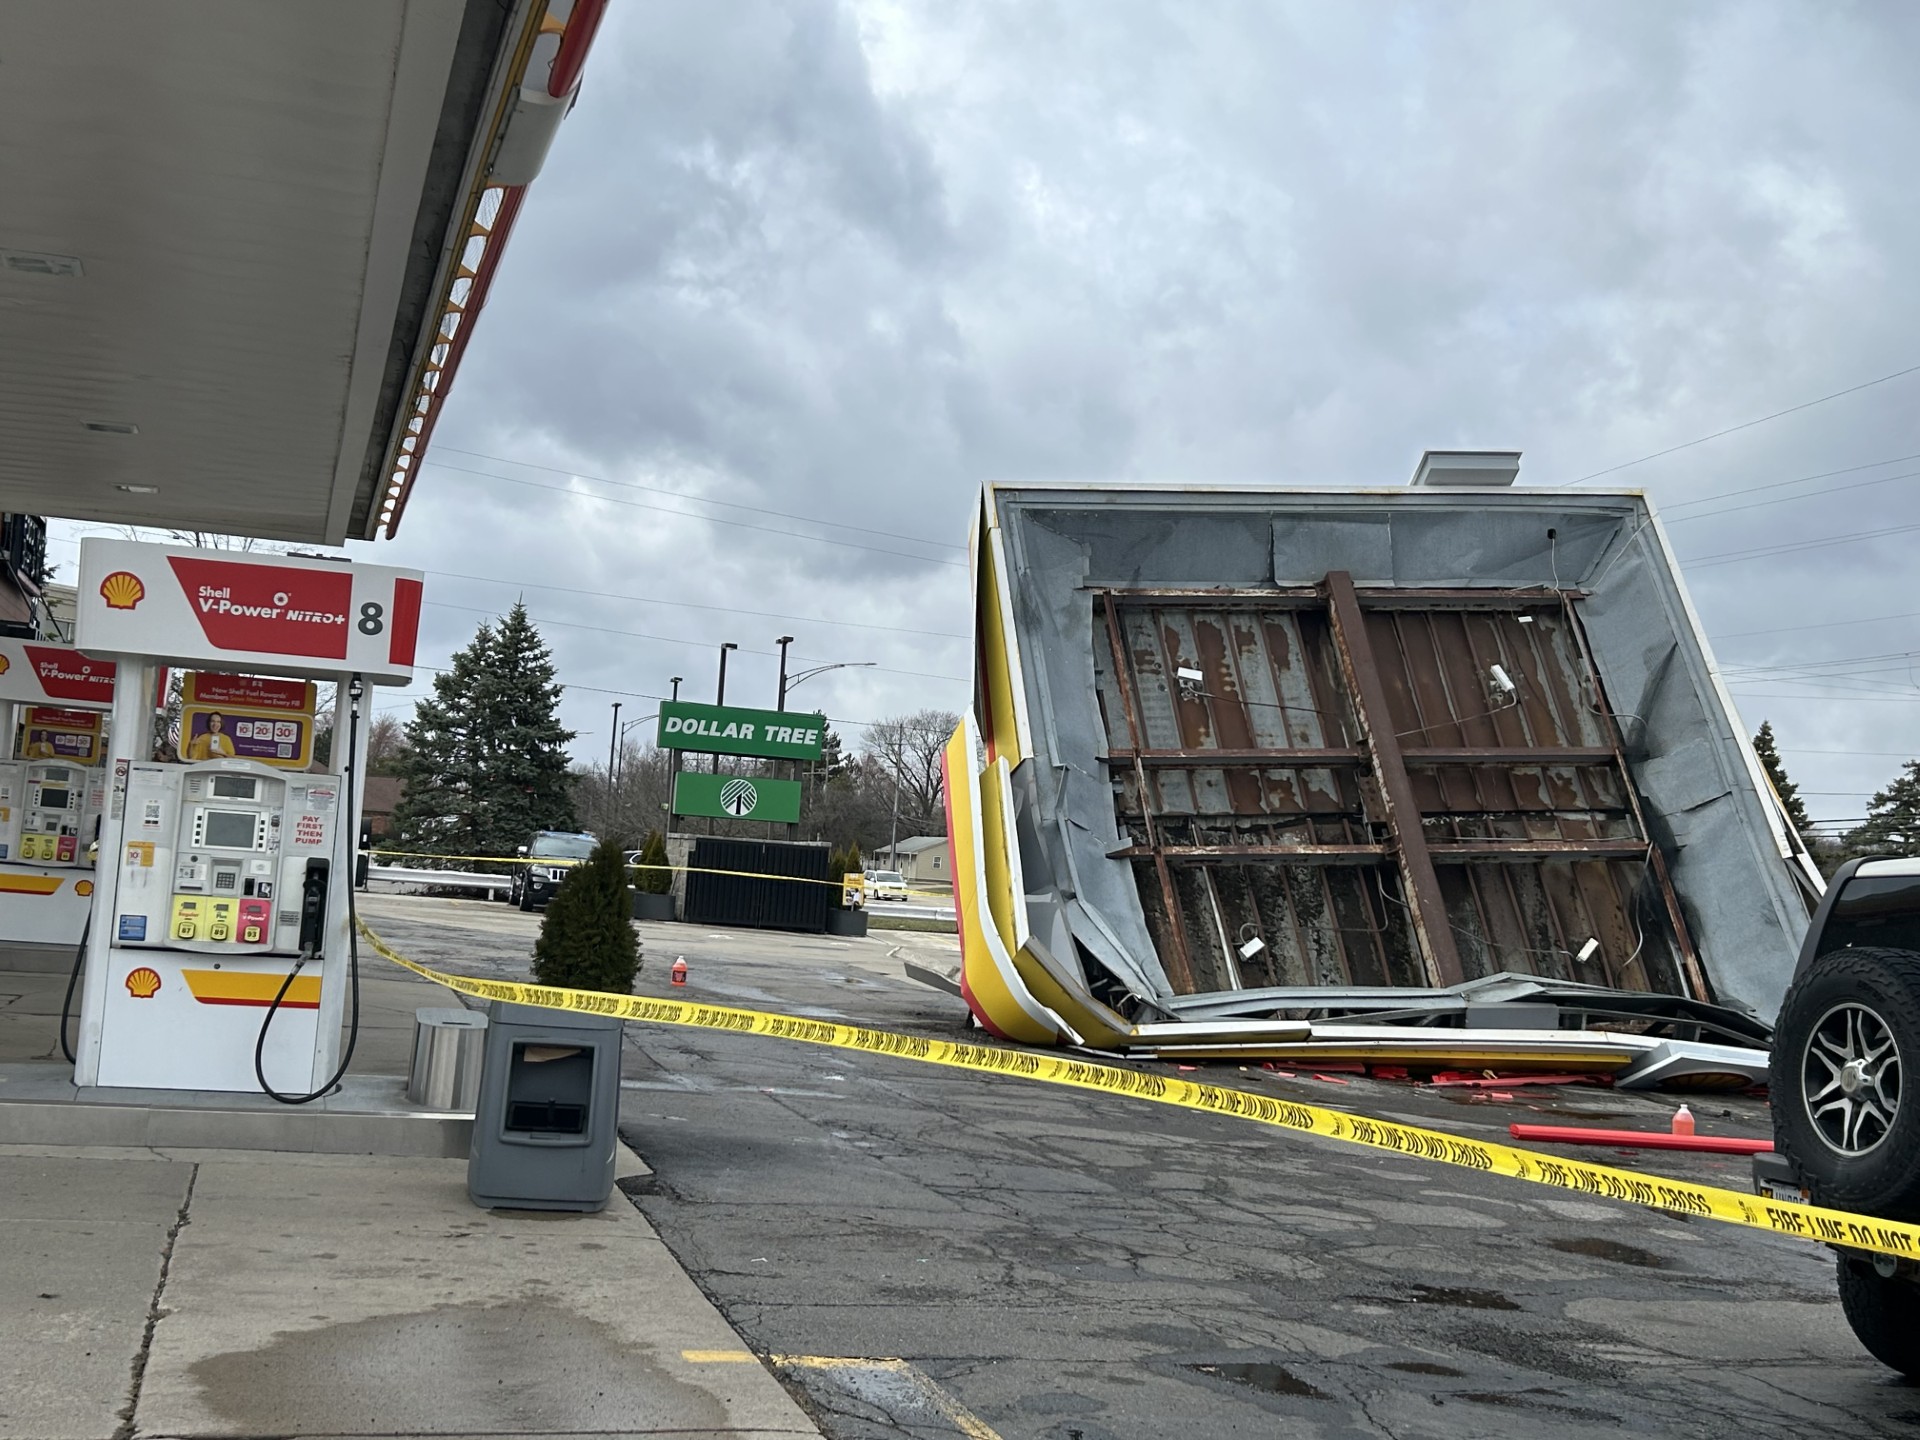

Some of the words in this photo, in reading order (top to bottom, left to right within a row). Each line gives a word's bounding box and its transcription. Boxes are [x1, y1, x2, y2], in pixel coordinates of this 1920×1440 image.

[198, 585, 231, 599] Shell
[198, 598, 281, 619] V-Power
[357, 602, 383, 636] 8
[40, 668, 87, 681] V-Power
[665, 717, 755, 740] DOLLAR
[764, 725, 819, 745] TREE
[296, 822, 324, 830] FIRST
[302, 815, 320, 823] PAY
[295, 837, 322, 845] PUMP
[1063, 1062, 1085, 1081] FIRE
[1083, 1065, 1105, 1085] LINE
[1103, 1068, 1118, 1087] DO
[1116, 1069, 1135, 1090] NOT
[1135, 1072, 1166, 1097] CROSS
[1196, 1085, 1219, 1108] FIRE
[1218, 1088, 1241, 1113] LINE
[1241, 1093, 1257, 1116] DO
[1256, 1097, 1277, 1120] NOT
[1278, 1102, 1314, 1129] CROSS
[1349, 1118, 1376, 1144] FIRE
[1375, 1123, 1404, 1150] LINE
[1402, 1129, 1423, 1154] DO
[1421, 1134, 1448, 1160] NOT
[1448, 1140, 1493, 1170] CROSS
[1535, 1159, 1569, 1187] FIRE
[1567, 1166, 1603, 1194] LINE
[1601, 1173, 1627, 1199] DO
[1624, 1179, 1656, 1206] NOT
[1657, 1185, 1712, 1216] CROSS
